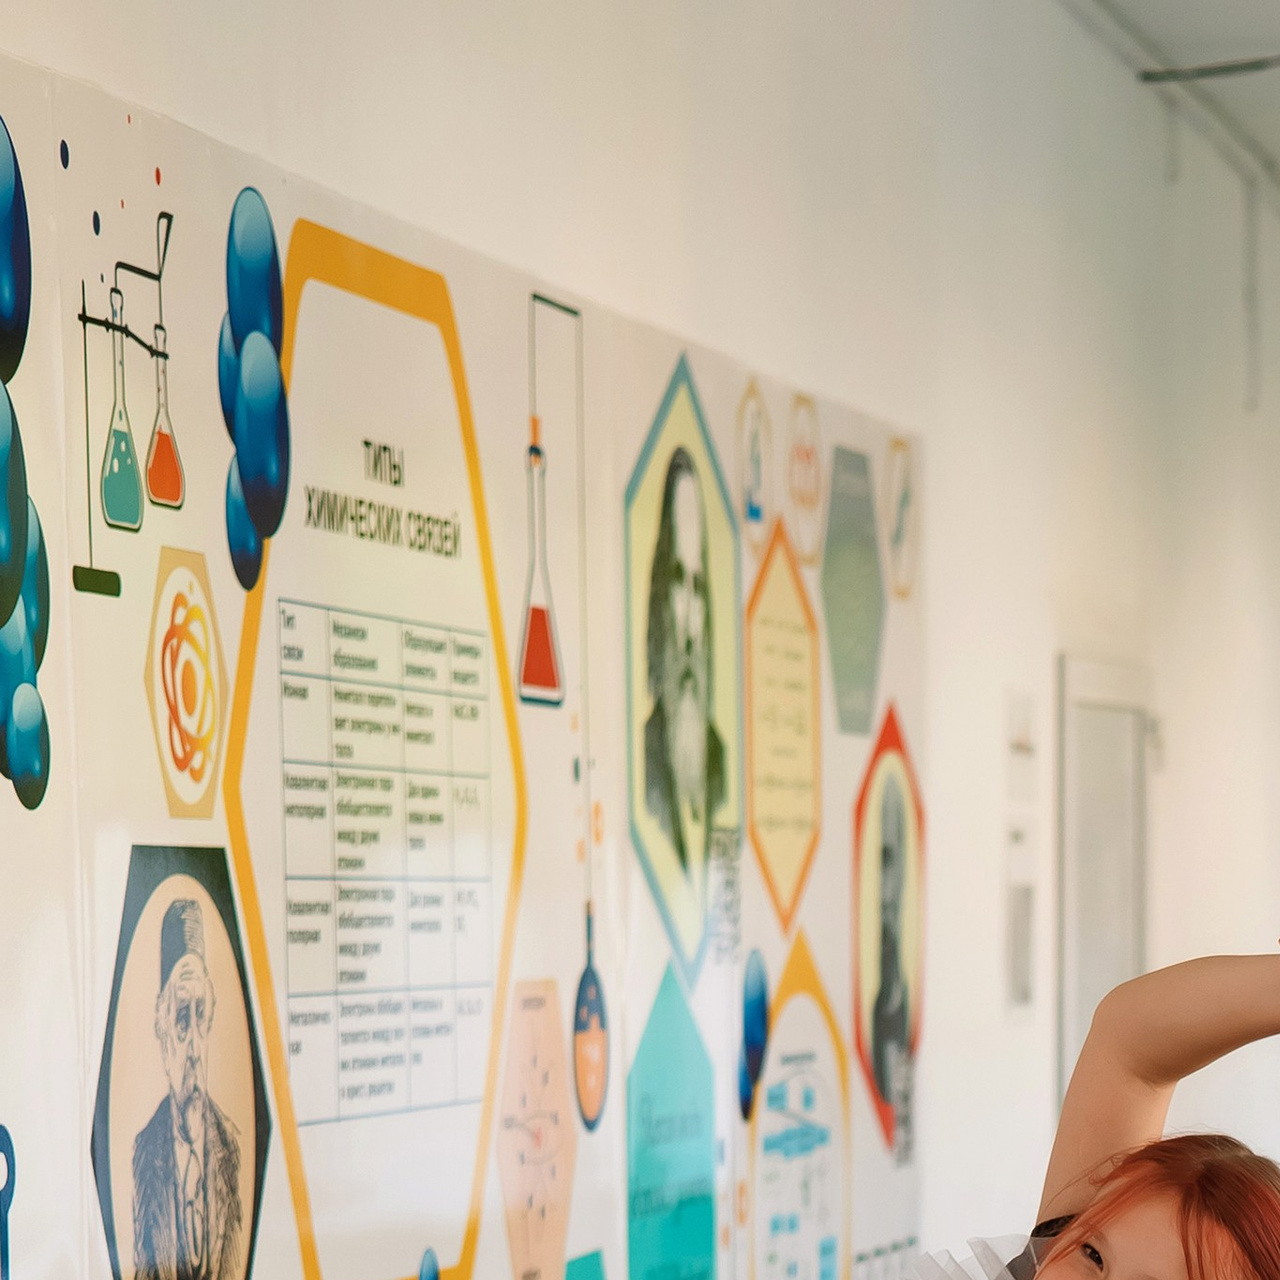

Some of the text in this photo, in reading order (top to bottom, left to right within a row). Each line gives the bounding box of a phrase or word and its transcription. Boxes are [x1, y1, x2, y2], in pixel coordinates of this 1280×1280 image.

[362, 439, 405, 487] ТИПЫ
[303, 484, 462, 558] ХИМИЧЕСКИХ СВЯЗЕЙ
